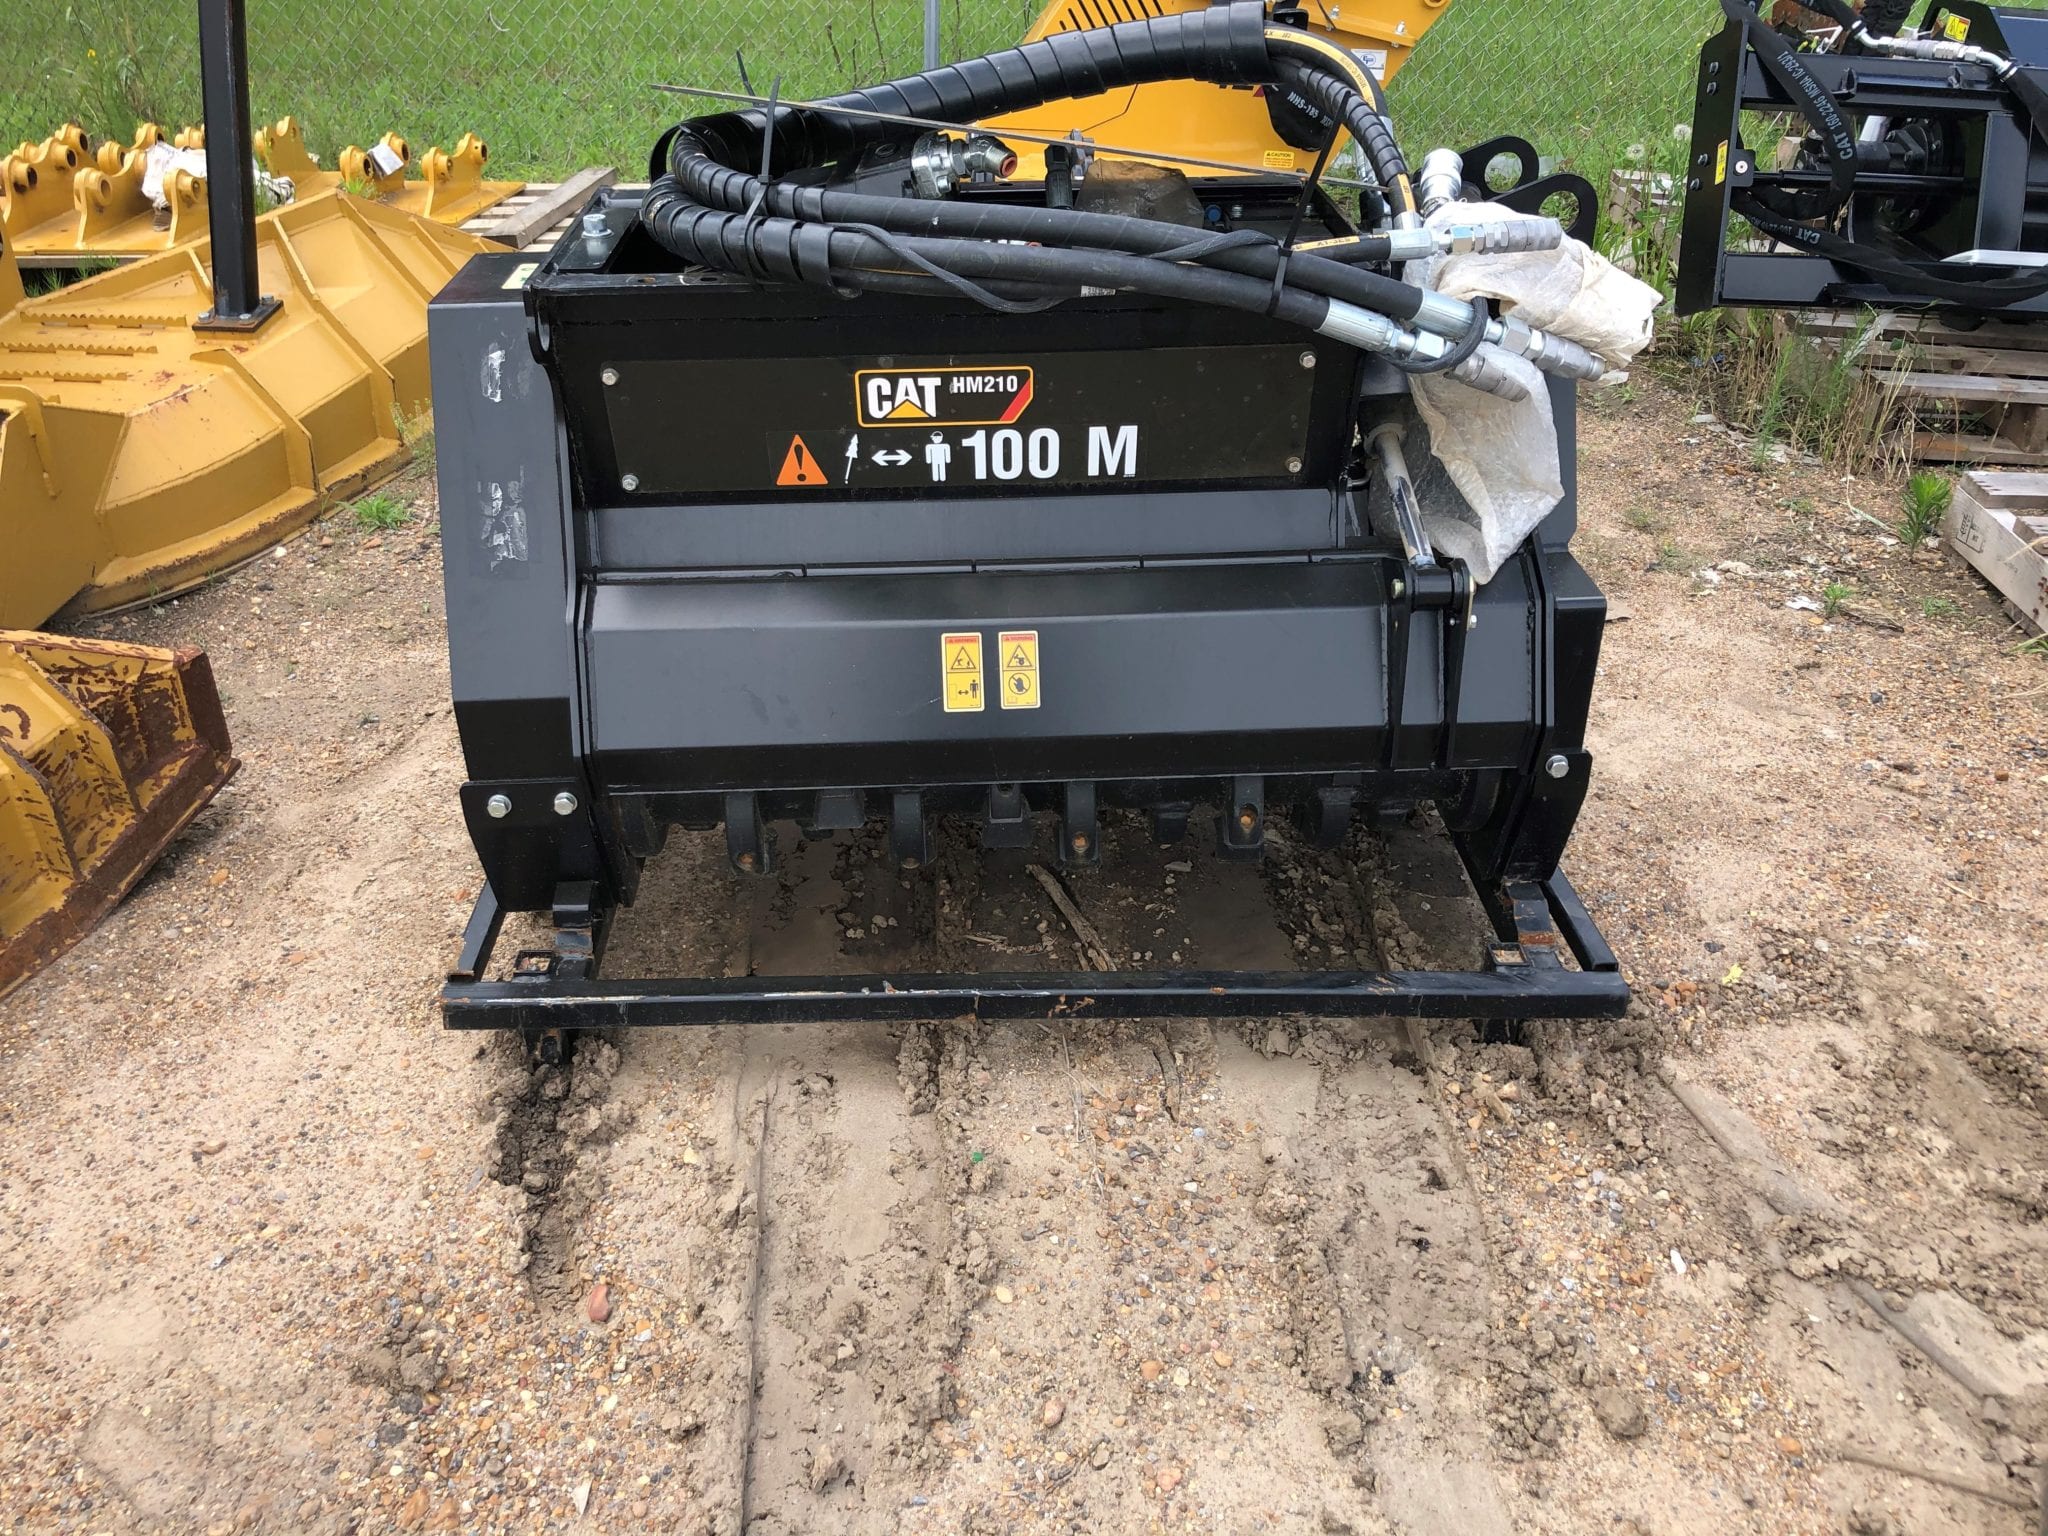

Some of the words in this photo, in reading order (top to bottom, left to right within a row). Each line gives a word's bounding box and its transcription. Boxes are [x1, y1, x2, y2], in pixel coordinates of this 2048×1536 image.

[1799, 75, 1820, 99] MSHA
[1832, 132, 1853, 160] CAT
[1795, 227, 1820, 245] CAT
[867, 377, 941, 419] CAT
[953, 375, 1018, 394] HM210
[962, 427, 1060, 481] 100
[1087, 425, 1138, 478] M
